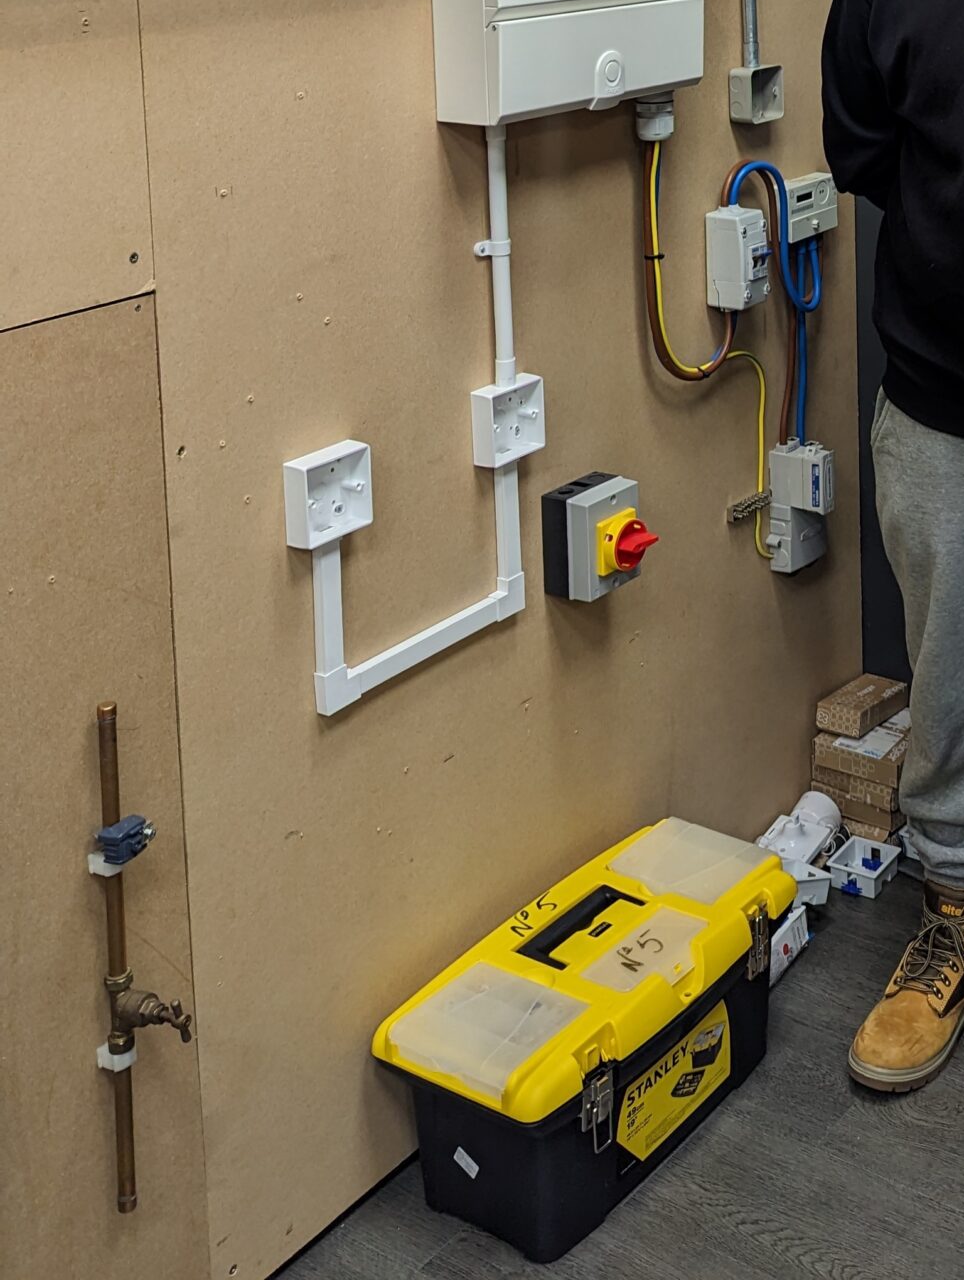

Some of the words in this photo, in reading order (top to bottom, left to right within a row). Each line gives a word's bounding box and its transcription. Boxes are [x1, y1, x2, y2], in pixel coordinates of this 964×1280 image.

[536, 891, 557, 911] 5
[636, 929, 664, 953] 5
[627, 1041, 689, 1108] STANLEY
